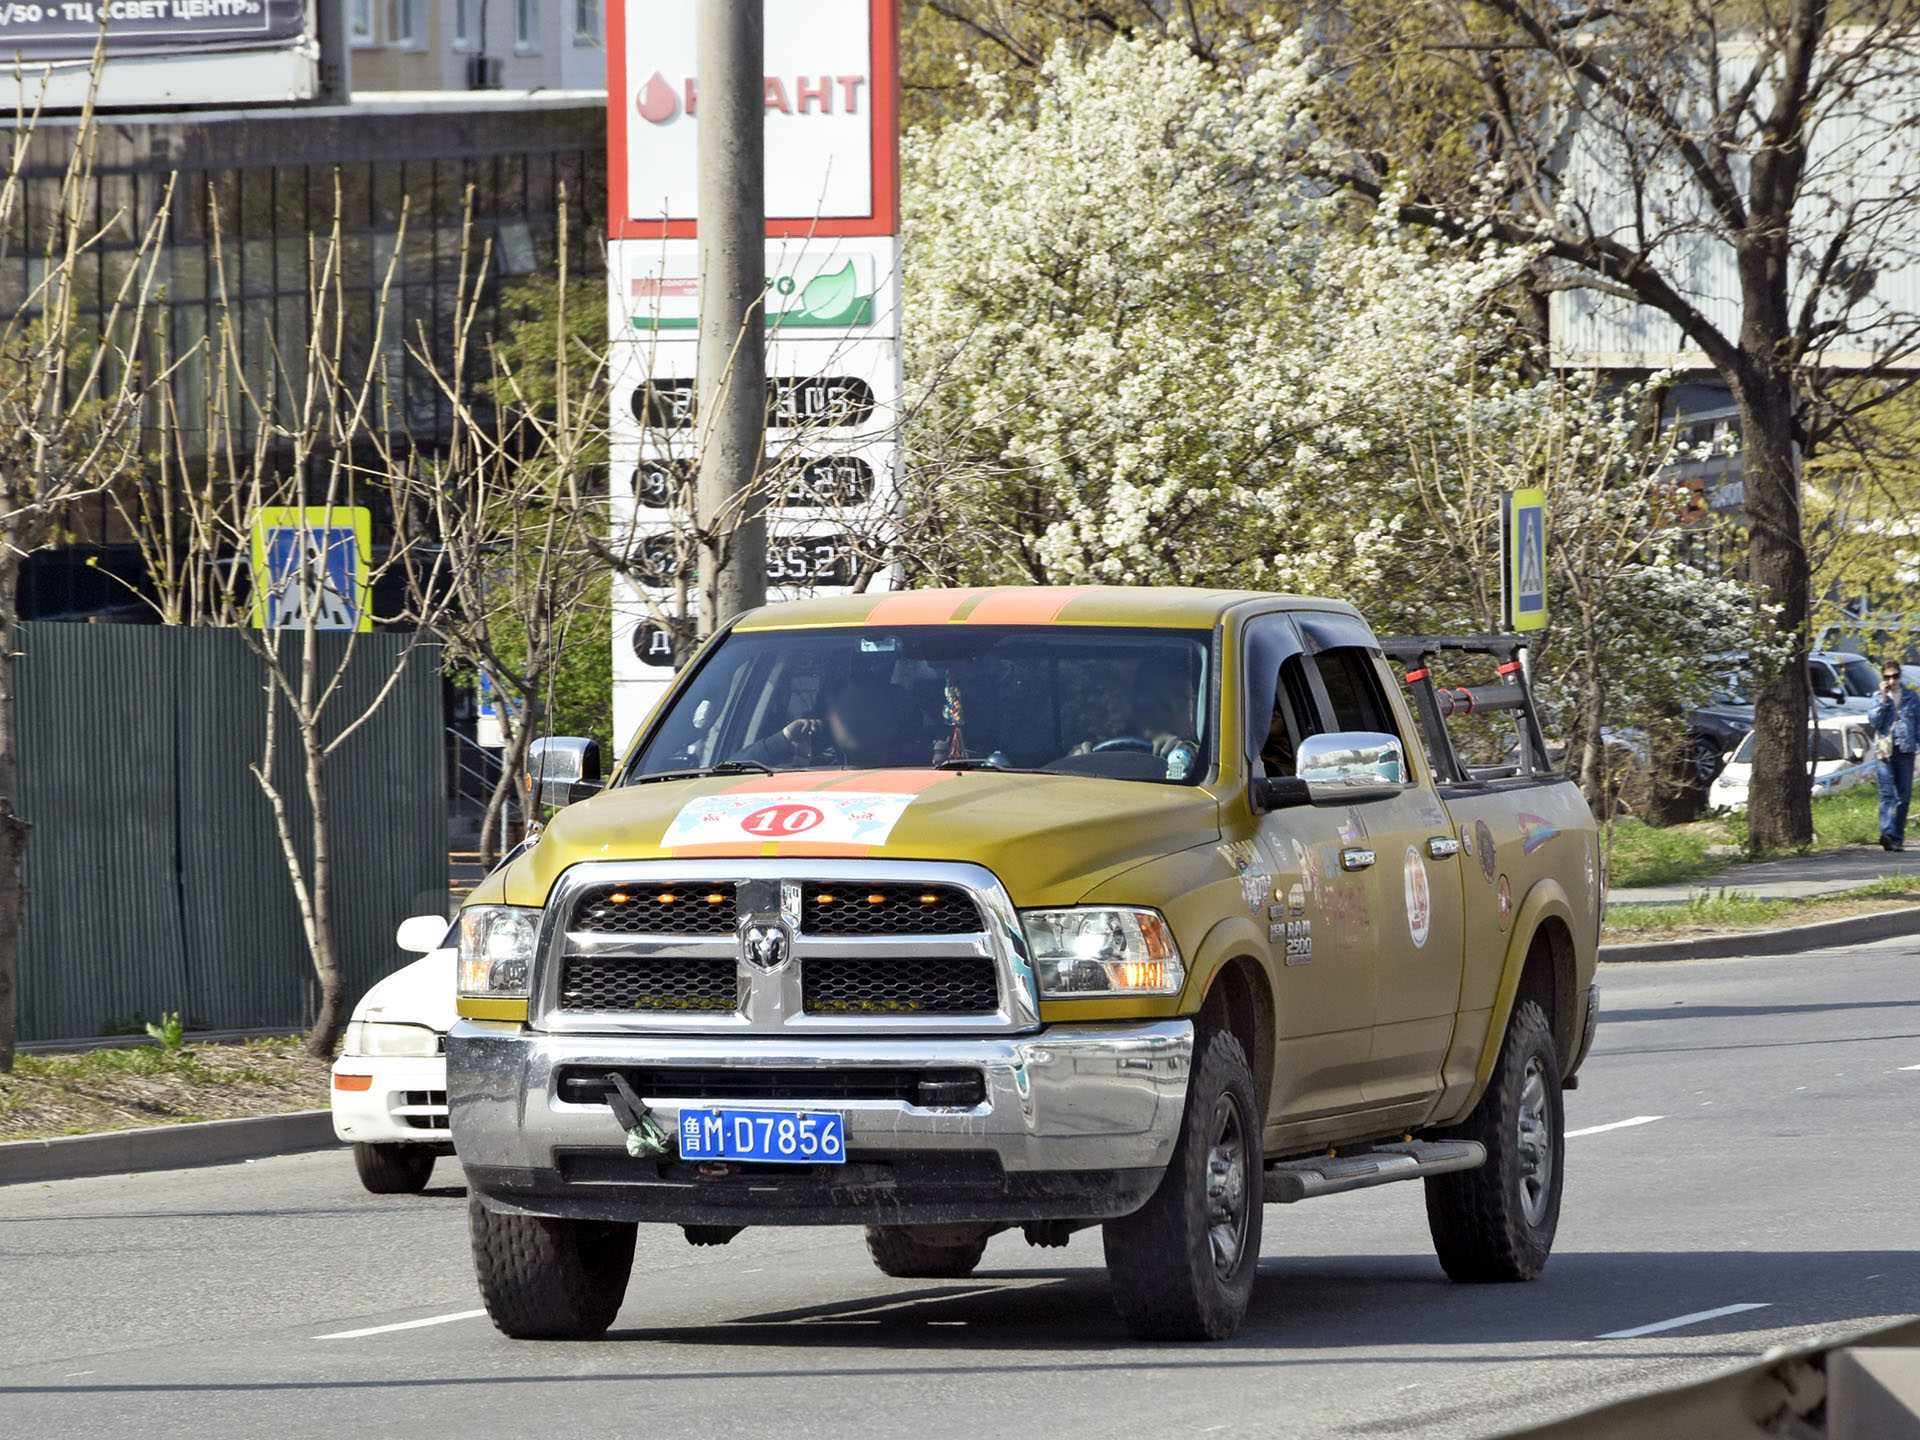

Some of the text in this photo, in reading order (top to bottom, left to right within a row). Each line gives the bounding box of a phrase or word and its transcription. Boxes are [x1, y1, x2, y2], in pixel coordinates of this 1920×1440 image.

[61, 3, 94, 23] ТЦ
[172, 0, 260, 20] ЦЕНТР»
[685, 75, 864, 114] АНТ
[749, 810, 817, 831] 10
[1287, 920, 1311, 936] RAM
[1287, 937, 1312, 954] 2500
